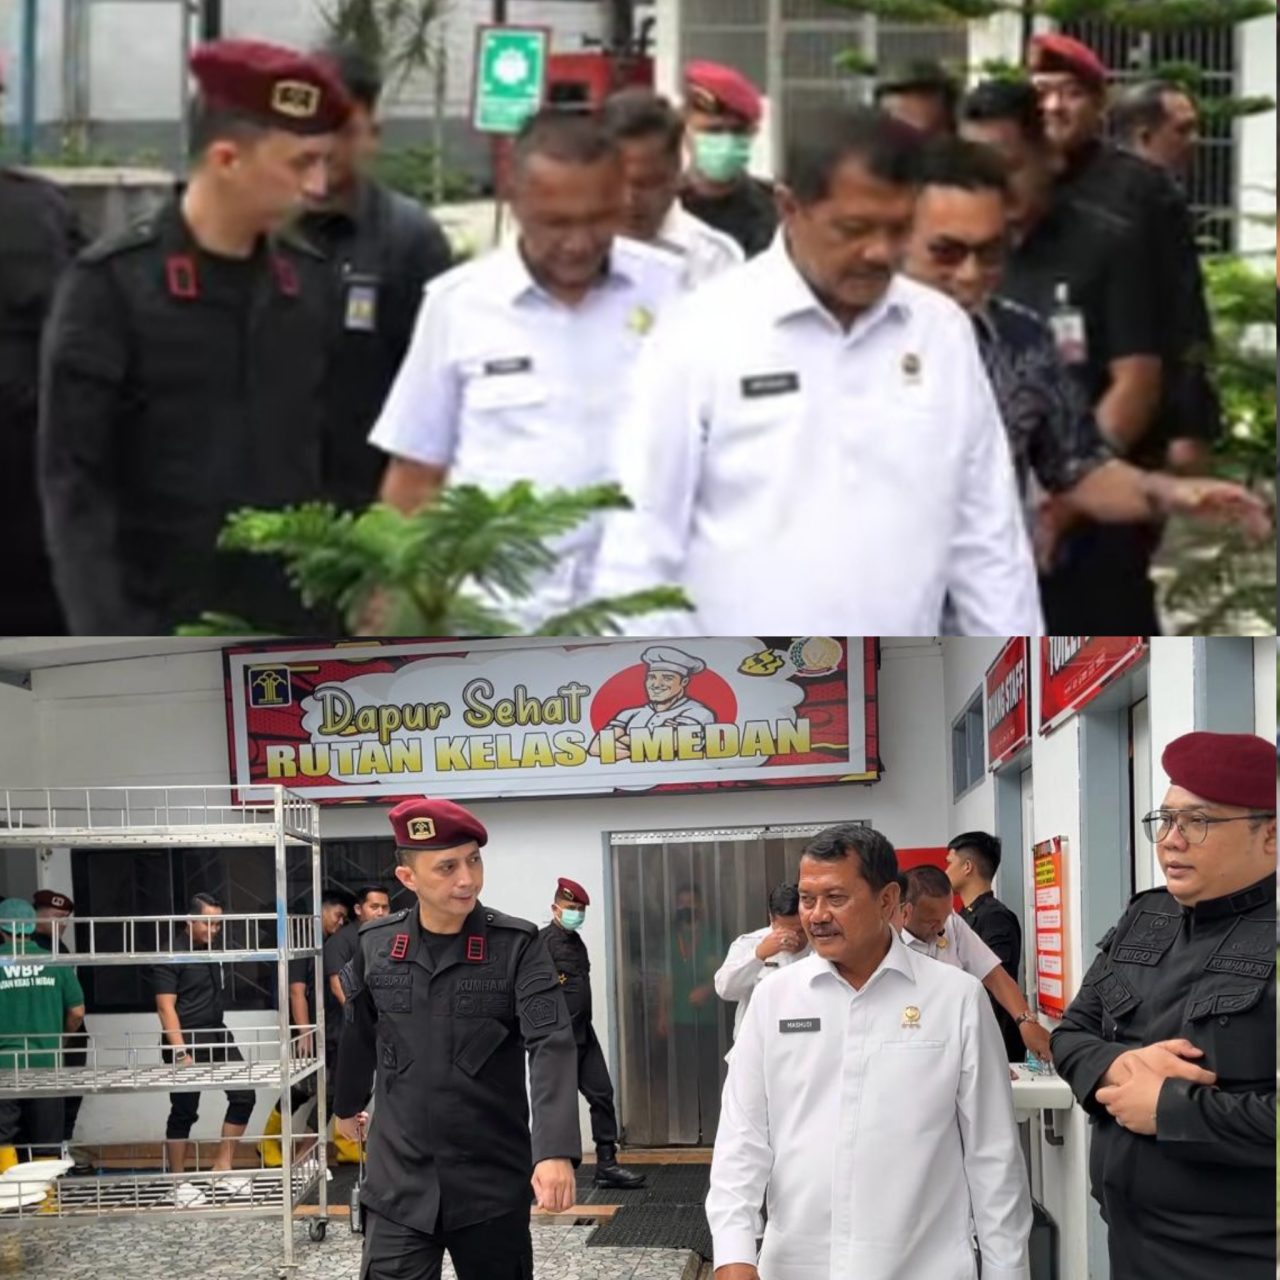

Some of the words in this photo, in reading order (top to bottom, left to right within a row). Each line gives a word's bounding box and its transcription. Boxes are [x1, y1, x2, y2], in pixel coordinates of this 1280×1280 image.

[313, 686, 450, 745] Dapur
[462, 677, 591, 728] Sehat
[266, 737, 423, 779] RUTAN
[434, 729, 588, 772] KELAS
[600, 729, 617, 765] I
[630, 718, 811, 763] MEDAN
